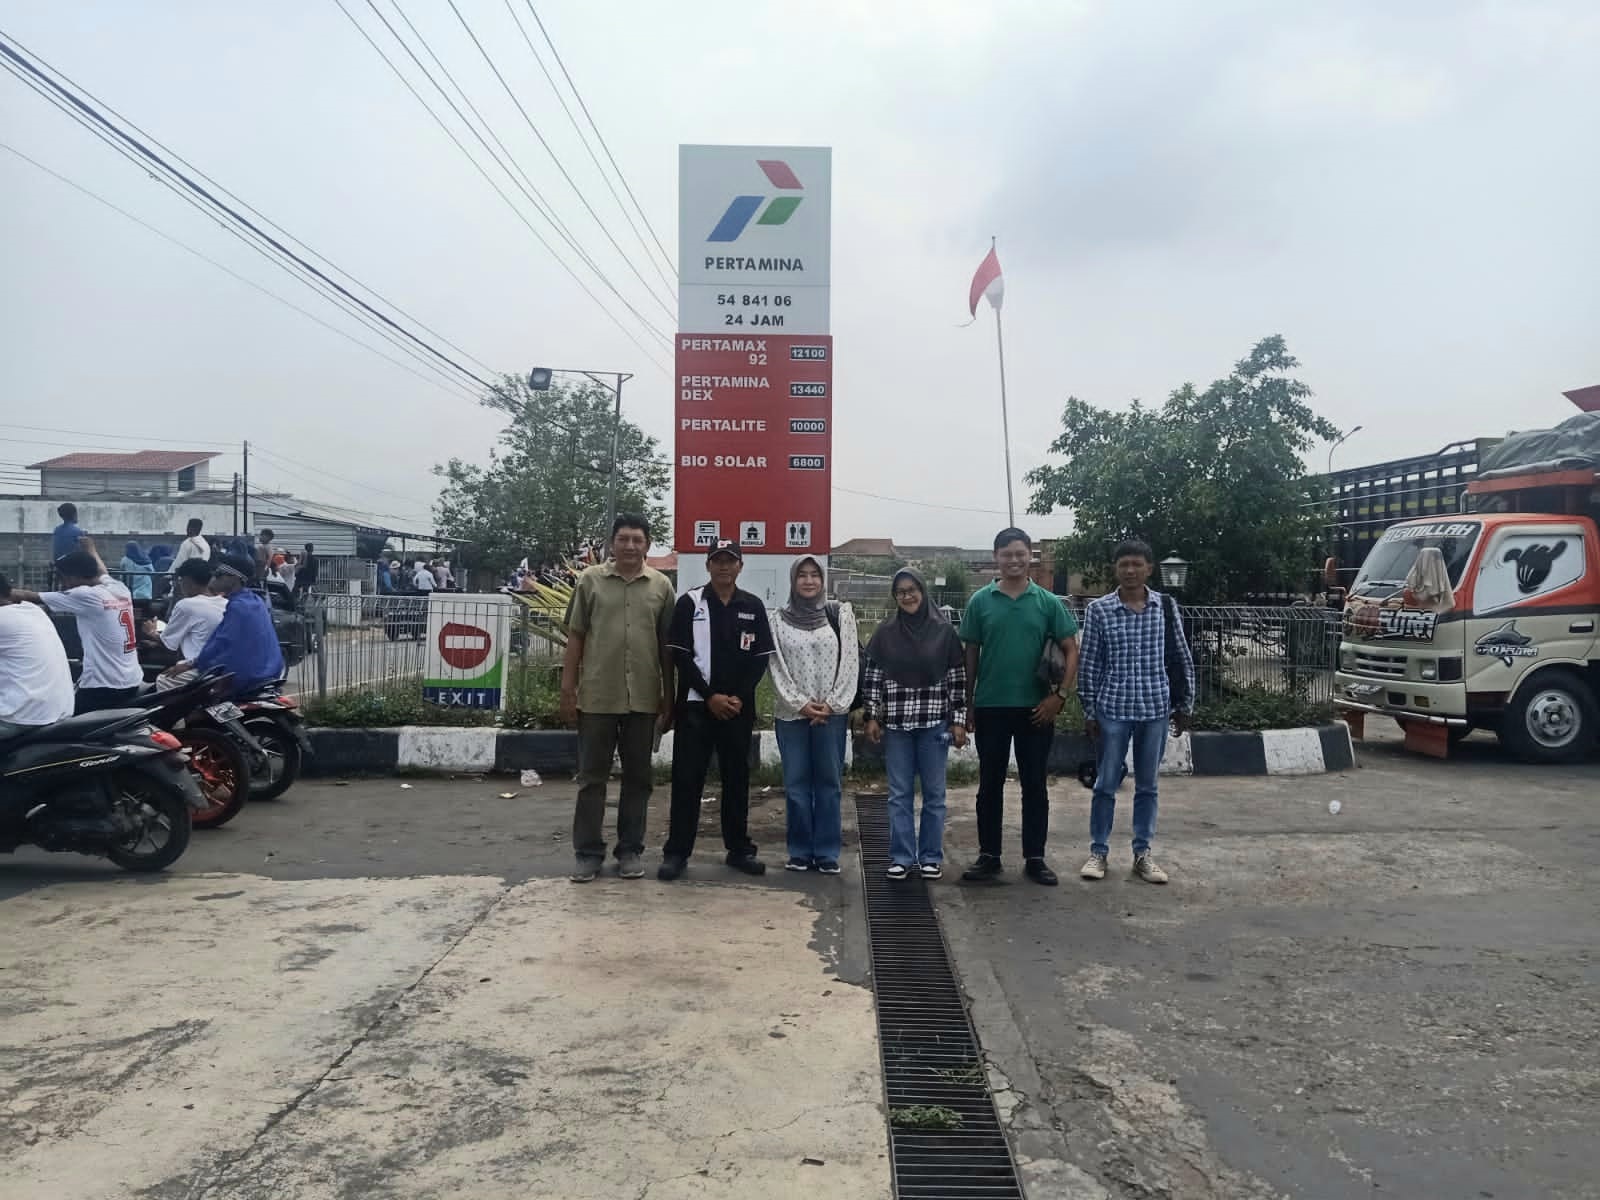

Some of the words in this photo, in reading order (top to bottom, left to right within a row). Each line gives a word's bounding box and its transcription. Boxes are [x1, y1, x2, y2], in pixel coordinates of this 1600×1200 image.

[704, 256, 804, 271] PERTAMINA
[717, 294, 736, 306] 54
[742, 295, 768, 306] 841
[774, 295, 792, 307] 06
[725, 314, 743, 326] 24
[750, 314, 784, 327] JAM
[681, 339, 767, 352] PERTAMAX
[749, 353, 768, 366] 92
[791, 348, 825, 359] 12100
[681, 375, 770, 389] PERTAMINA
[681, 389, 713, 401] DEX
[791, 385, 825, 395] 13440
[681, 418, 767, 432] PERTALITE
[791, 421, 825, 432] 10000
[681, 455, 708, 468] BIO
[714, 455, 768, 468] SOLAR
[793, 457, 821, 467] 6800
[696, 535, 719, 544] ATM
[439, 691, 487, 705] EXIT
